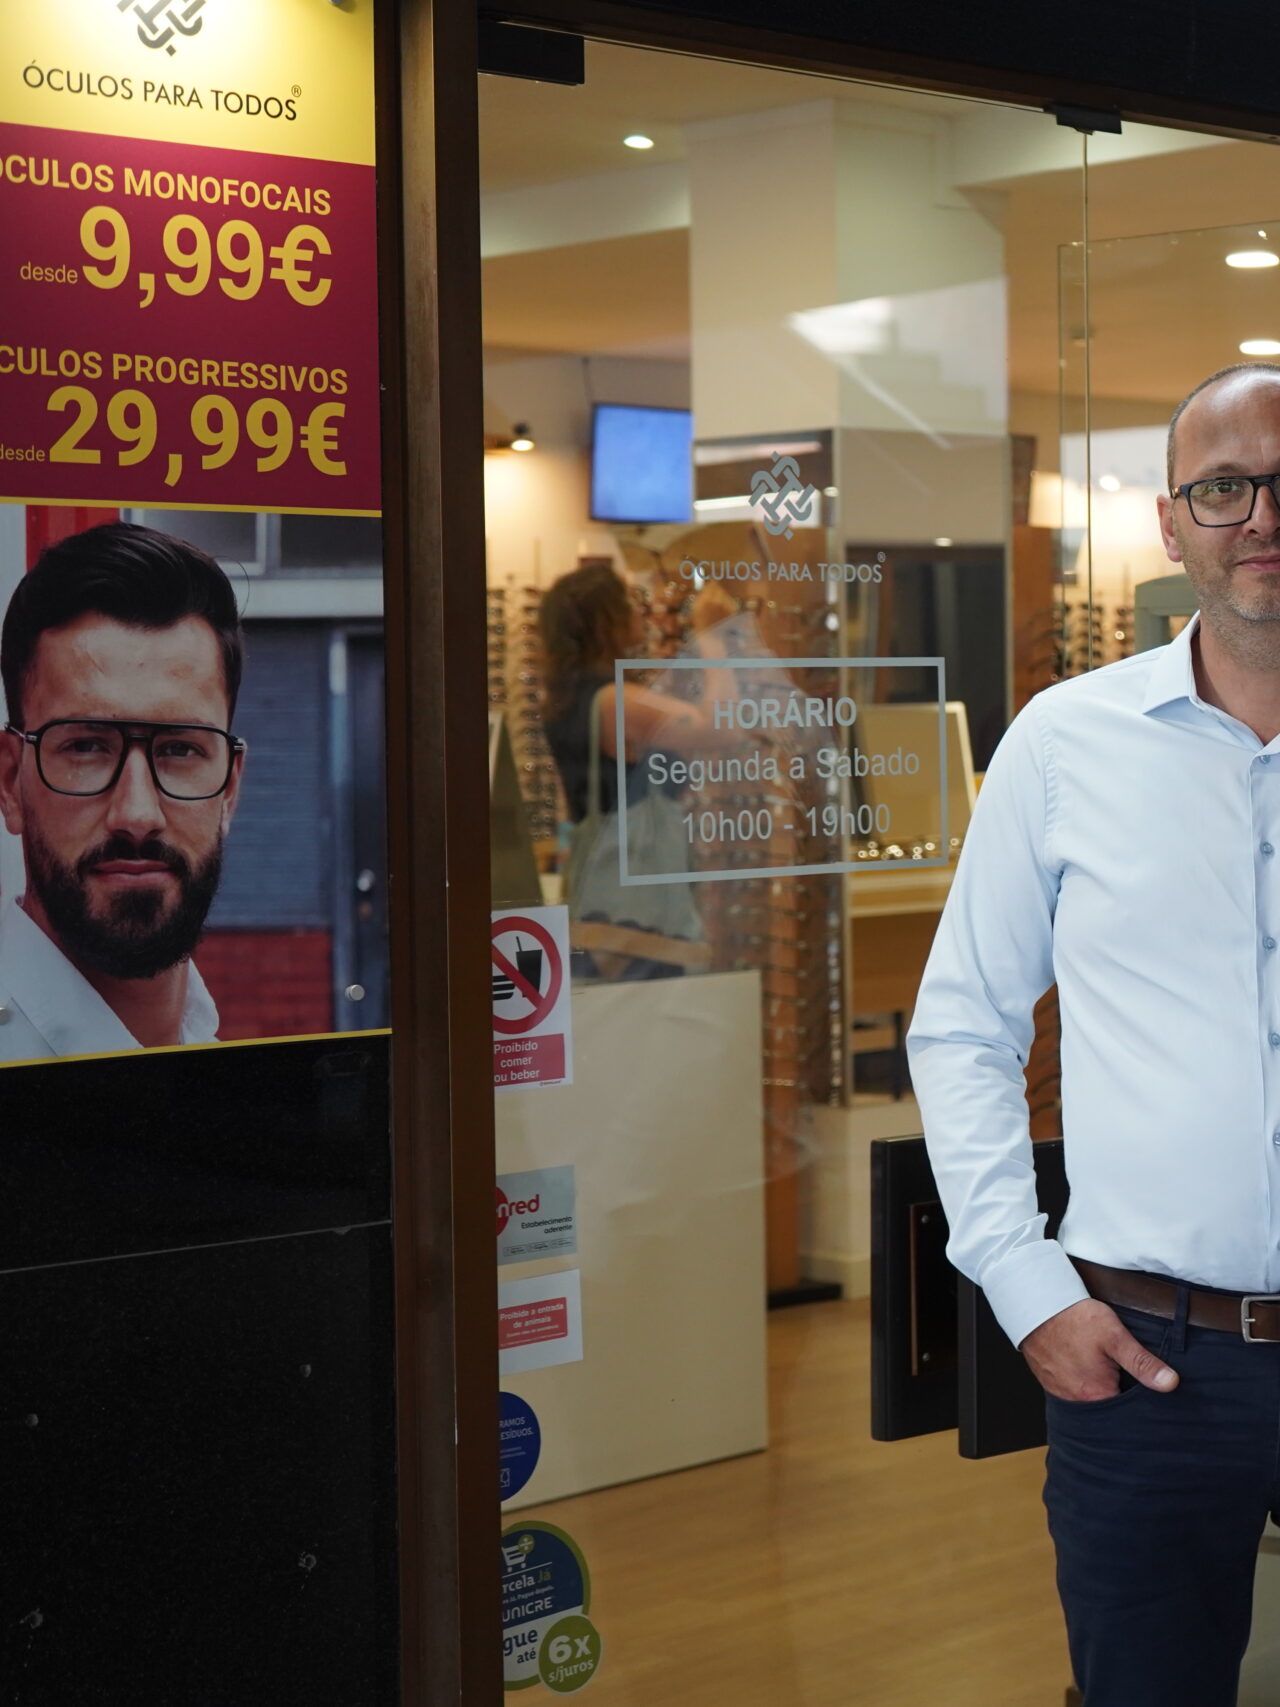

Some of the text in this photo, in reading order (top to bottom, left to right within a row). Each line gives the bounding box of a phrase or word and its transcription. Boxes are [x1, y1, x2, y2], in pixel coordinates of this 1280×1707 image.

[23, 60, 133, 100] ÓCULOS
[143, 81, 203, 109] PARA
[125, 168, 331, 216] MONOFOCAIS
[20, 206, 332, 308] desde 9,99€
[113, 353, 348, 394] PROGRESSIVOS
[47, 386, 347, 487] 29,99€
[679, 557, 761, 582] ÓCULOS
[767, 562, 813, 582] PARA
[713, 690, 857, 730] HORÁRIO
[648, 747, 920, 791] Segunda a Sábado
[682, 809, 772, 844] 10h00
[806, 804, 890, 838] 19h00
[494, 1041, 538, 1055] Proibido
[500, 1056, 533, 1068] comer
[510, 1069, 540, 1081] beber
[494, 1073, 508, 1083] ou
[521, 1215, 572, 1230] Estabelecimento
[544, 1224, 573, 1235] aderente
[516, 1647, 537, 1665] até
[548, 1634, 592, 1664] 6x
[547, 1659, 594, 1683] s/juros
